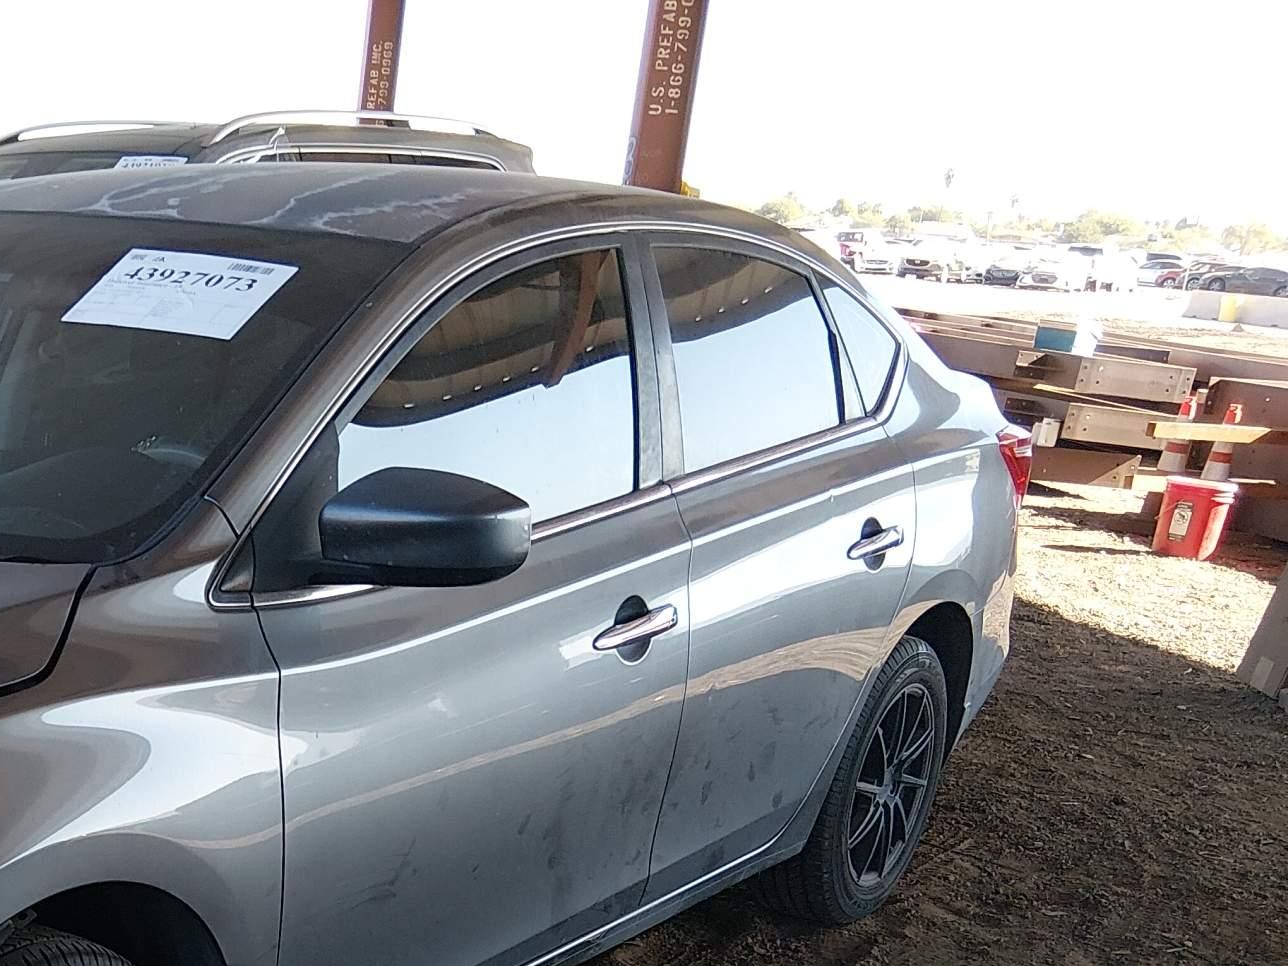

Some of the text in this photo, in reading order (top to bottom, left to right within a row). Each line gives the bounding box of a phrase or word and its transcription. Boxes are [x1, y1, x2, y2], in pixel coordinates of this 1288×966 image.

[647, 0, 678, 115] U.S. PREFAB
[366, 69, 379, 110] REFAB
[124, 266, 258, 291] 43927073
